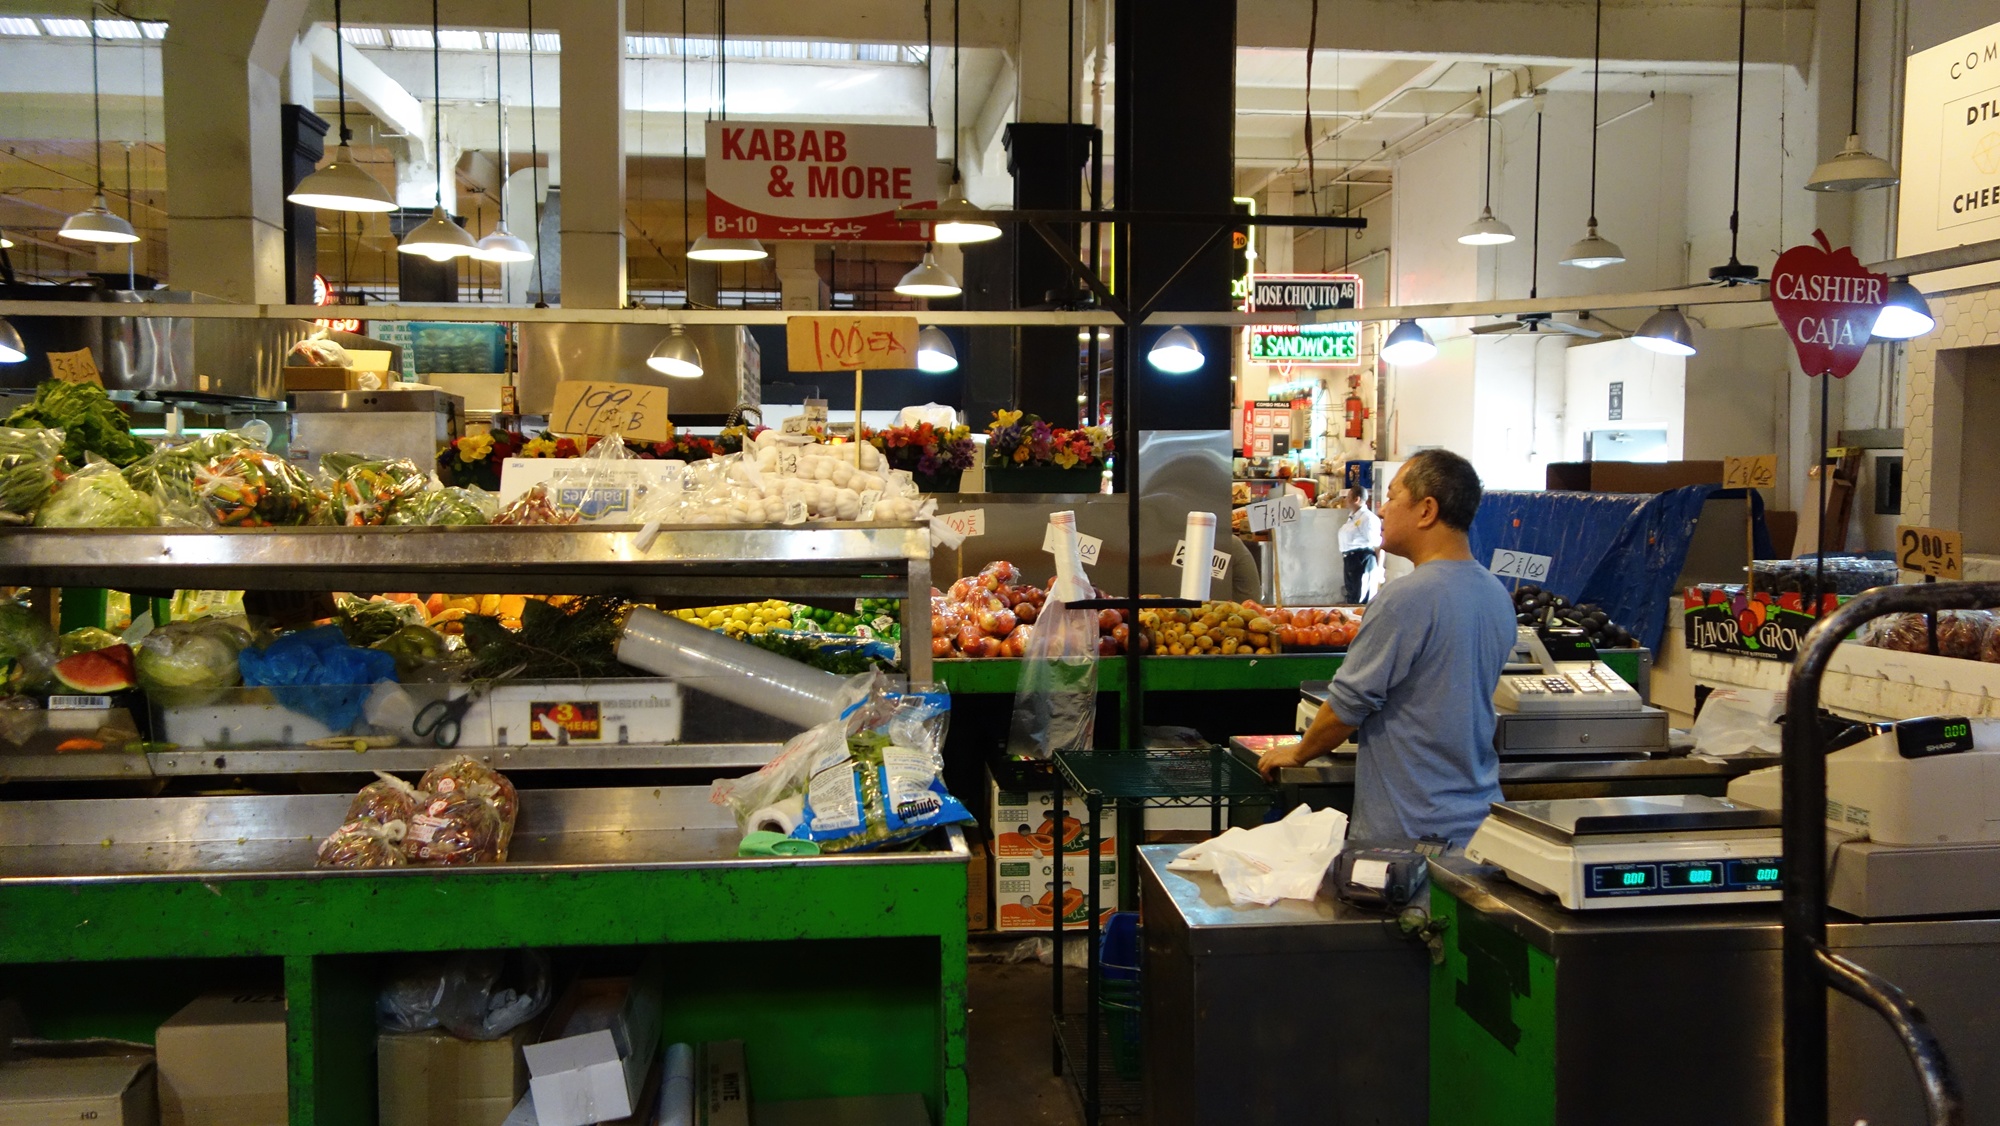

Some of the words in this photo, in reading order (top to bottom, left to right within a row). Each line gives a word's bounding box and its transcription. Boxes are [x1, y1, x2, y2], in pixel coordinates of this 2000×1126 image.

[722, 128, 848, 163] KABAB
[767, 165, 795, 198] &
[808, 166, 912, 199] MORE
[714, 216, 758, 234] B-10
[1256, 285, 1283, 305] JOSE
[1284, 285, 1339, 309] CHIQUITO
[1340, 283, 1354, 298] A6
[1776, 273, 1882, 304] CASHIER
[867, 331, 907, 355] EA
[1797, 317, 1855, 350] CAJA
[1253, 334, 1263, 356] &
[1267, 335, 1356, 357] SANDWICHES
[1254, 505, 1267, 528] 7
[1497, 552, 1516, 574] 2
[1694, 616, 1740, 648] FLAVOR
[557, 703, 574, 721] 3
[1944, 723, 1967, 738] 0.00
[1926, 742, 1957, 752] SHARP
